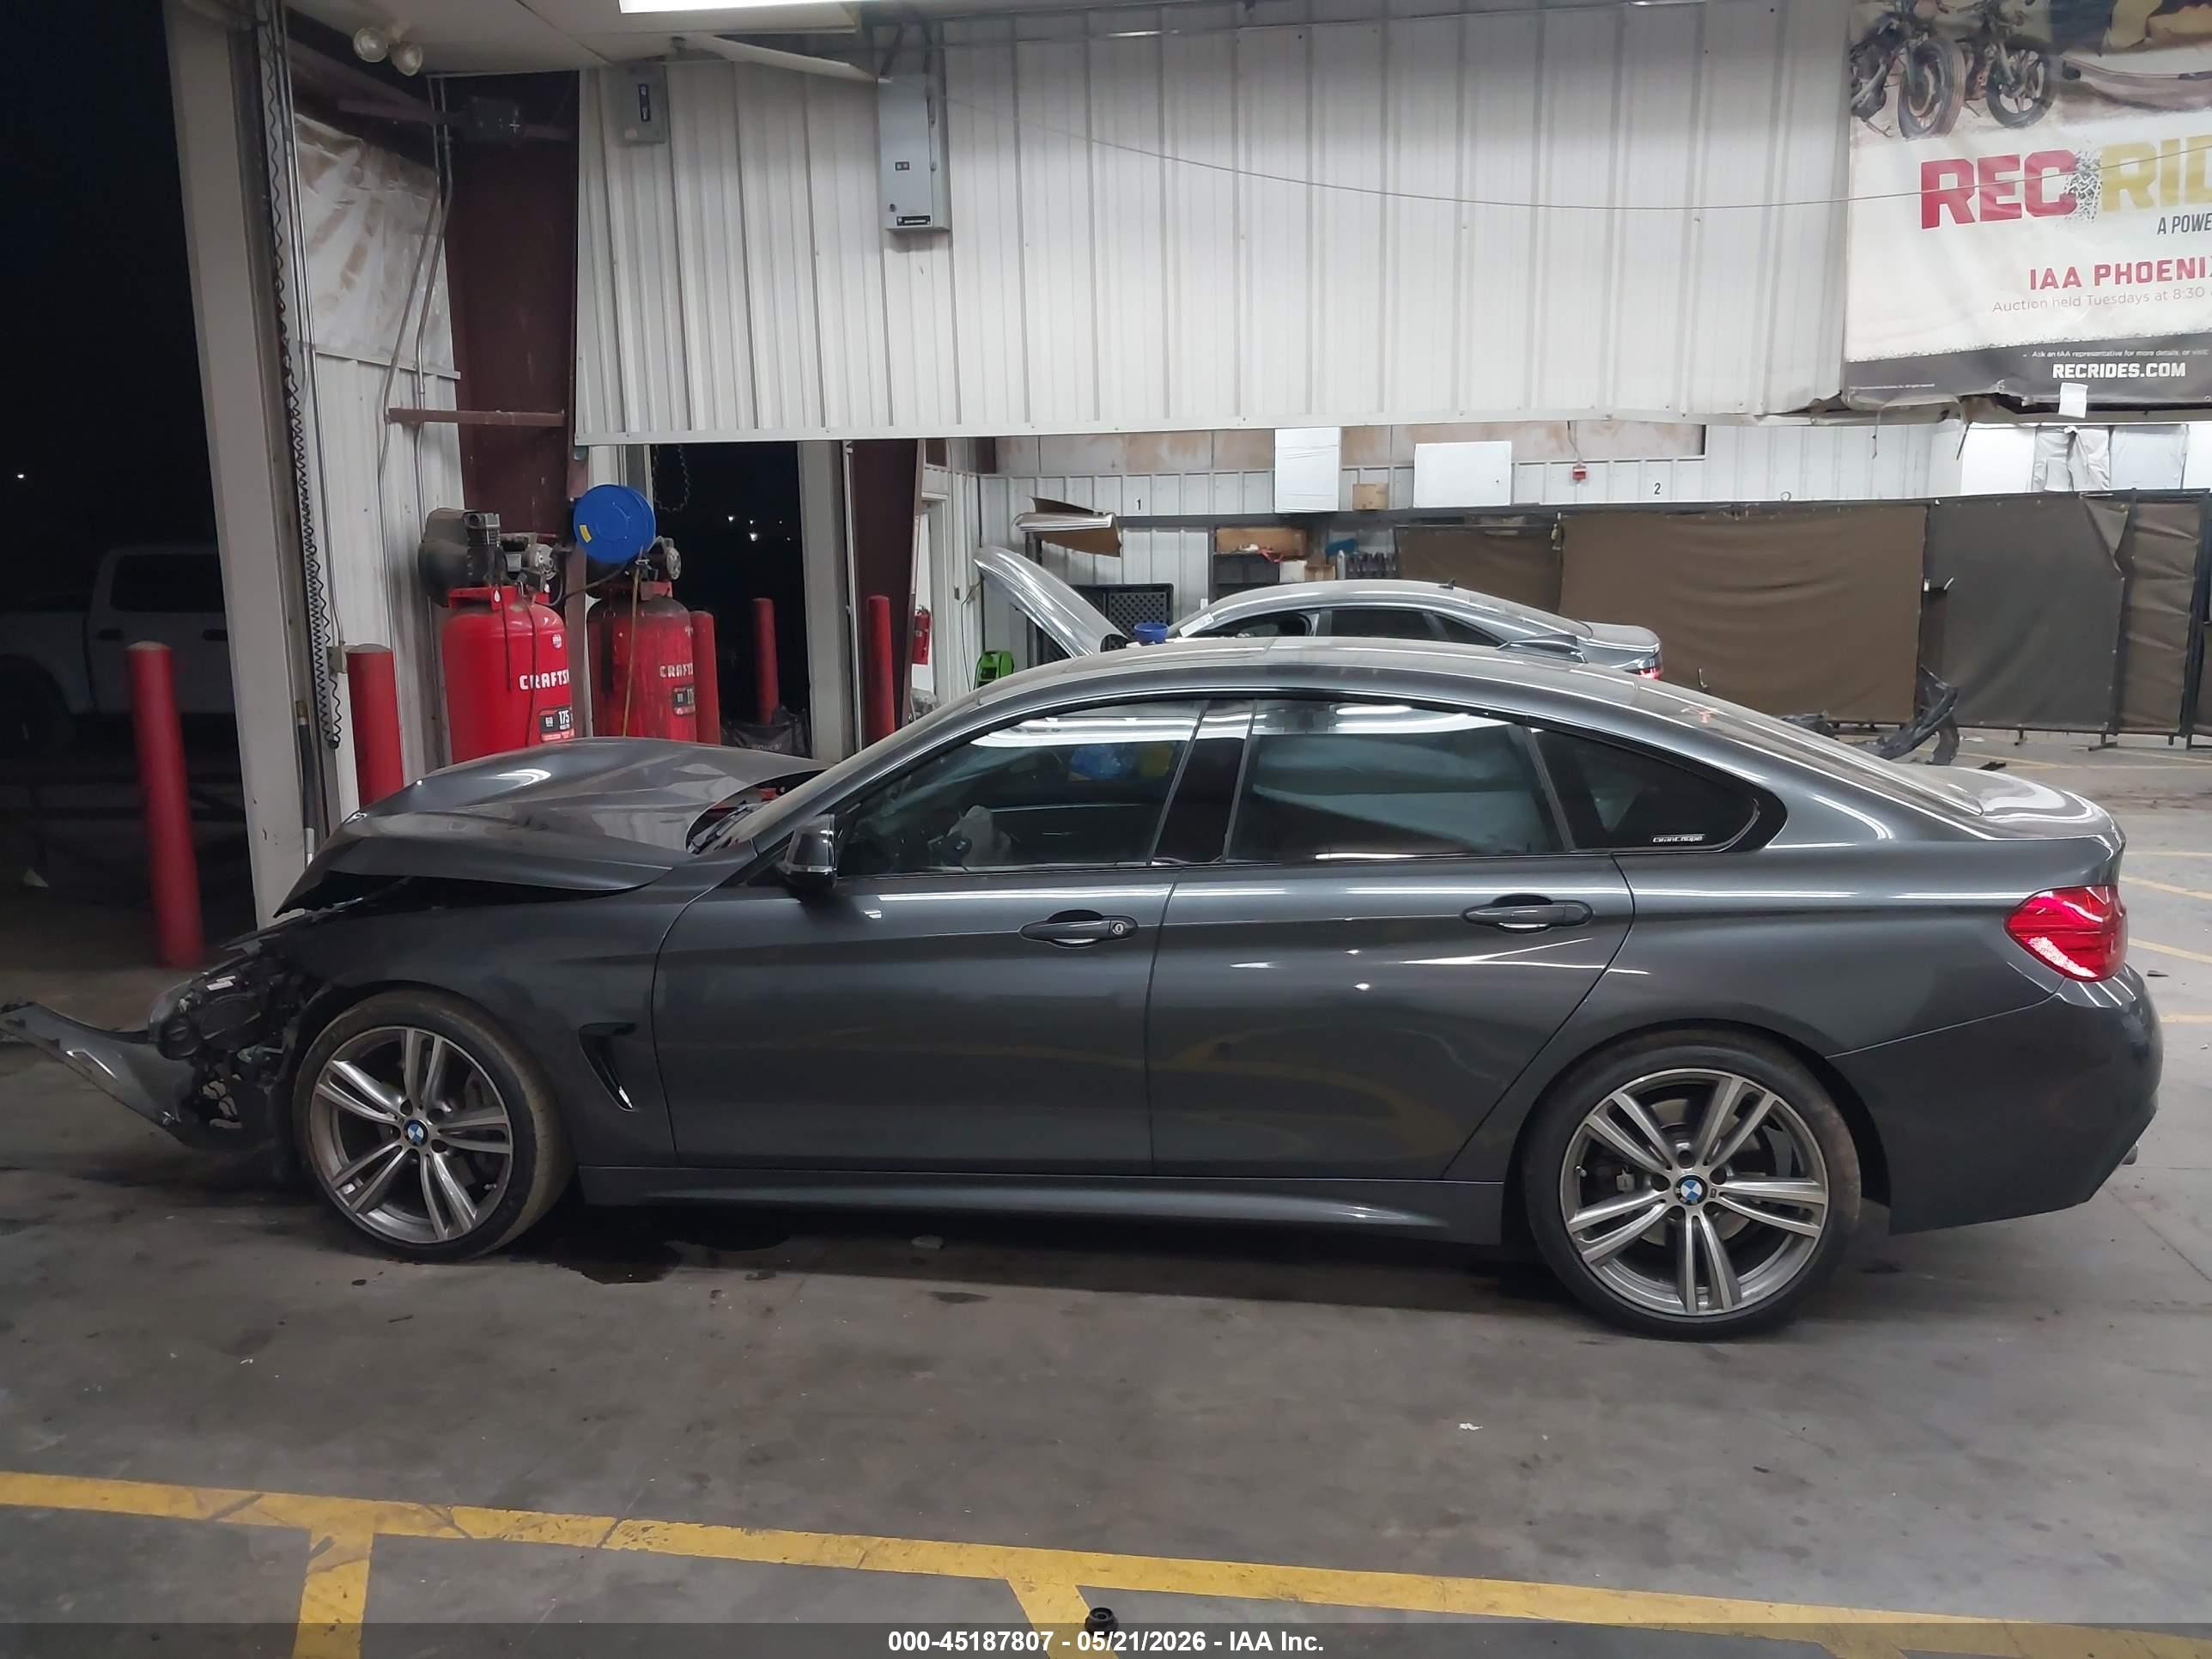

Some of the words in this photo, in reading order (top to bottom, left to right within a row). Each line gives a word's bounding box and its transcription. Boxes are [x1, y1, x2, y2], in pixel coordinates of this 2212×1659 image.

[1921, 149, 2078, 229] REC
[2157, 216, 2166, 235] A
[2029, 266, 2082, 290] IAA
[2094, 255, 2212, 287] PHOENI
[1991, 297, 2048, 313] Auction
[2052, 295, 2081, 308] held
[2086, 292, 2150, 307] Tuesdays
[2154, 290, 2168, 301] at
[2172, 286, 2205, 300] 8:30
[2052, 362, 2186, 379] RECRIDES.COM
[1654, 482, 1662, 495] 2
[1136, 498, 1141, 511] 1
[519, 669, 570, 690] CRAFTS
[558, 709, 570, 726] 175
